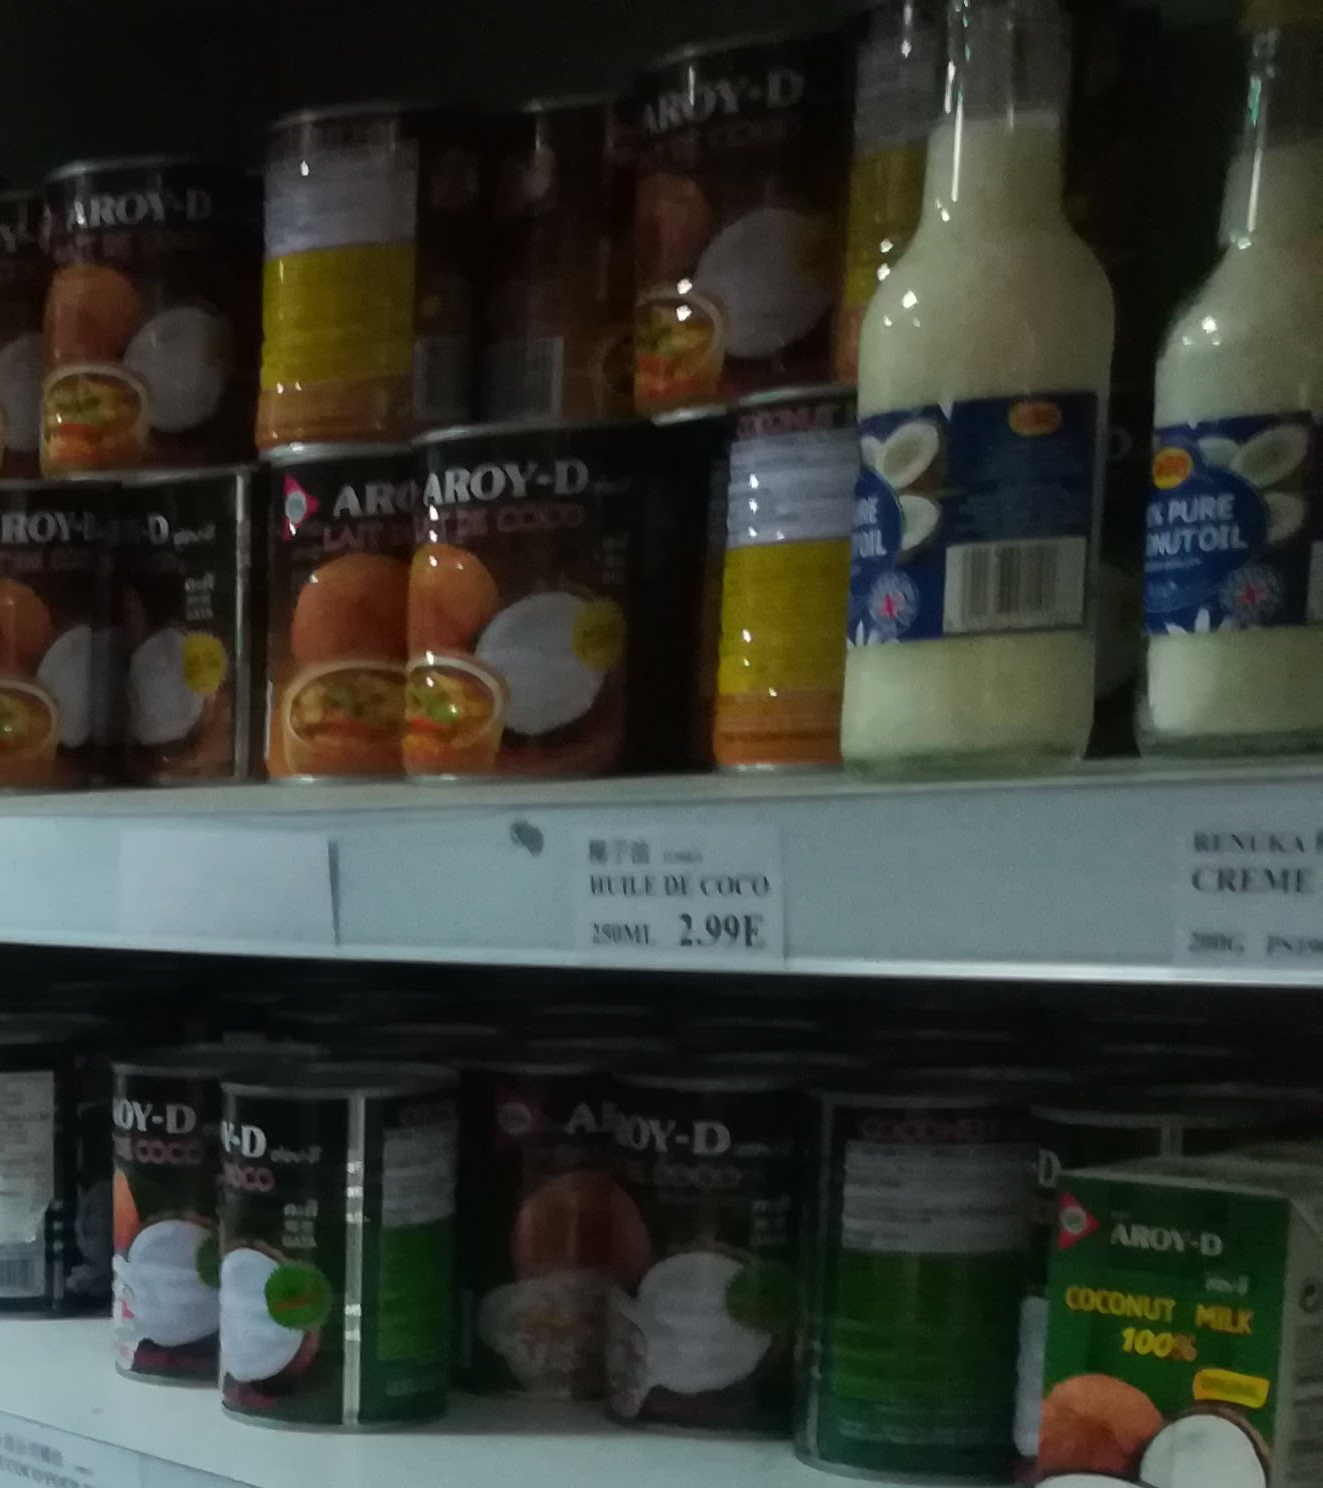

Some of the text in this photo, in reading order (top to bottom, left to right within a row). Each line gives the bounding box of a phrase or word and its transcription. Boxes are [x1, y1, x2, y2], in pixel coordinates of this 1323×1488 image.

[67, 188, 211, 232] AROY-D
[423, 458, 590, 507] AROY-D
[1169, 492, 1236, 523] PURE
[1200, 521, 1249, 553] OIL
[699, 873, 770, 897] COCO
[1191, 866, 1314, 894] CREME
[678, 912, 764, 950] 2.99E
[1110, 1222, 1225, 1257] AROY-D
[1064, 1284, 1255, 1336] COCONUT MILK
[1119, 1326, 1199, 1364] 100%
